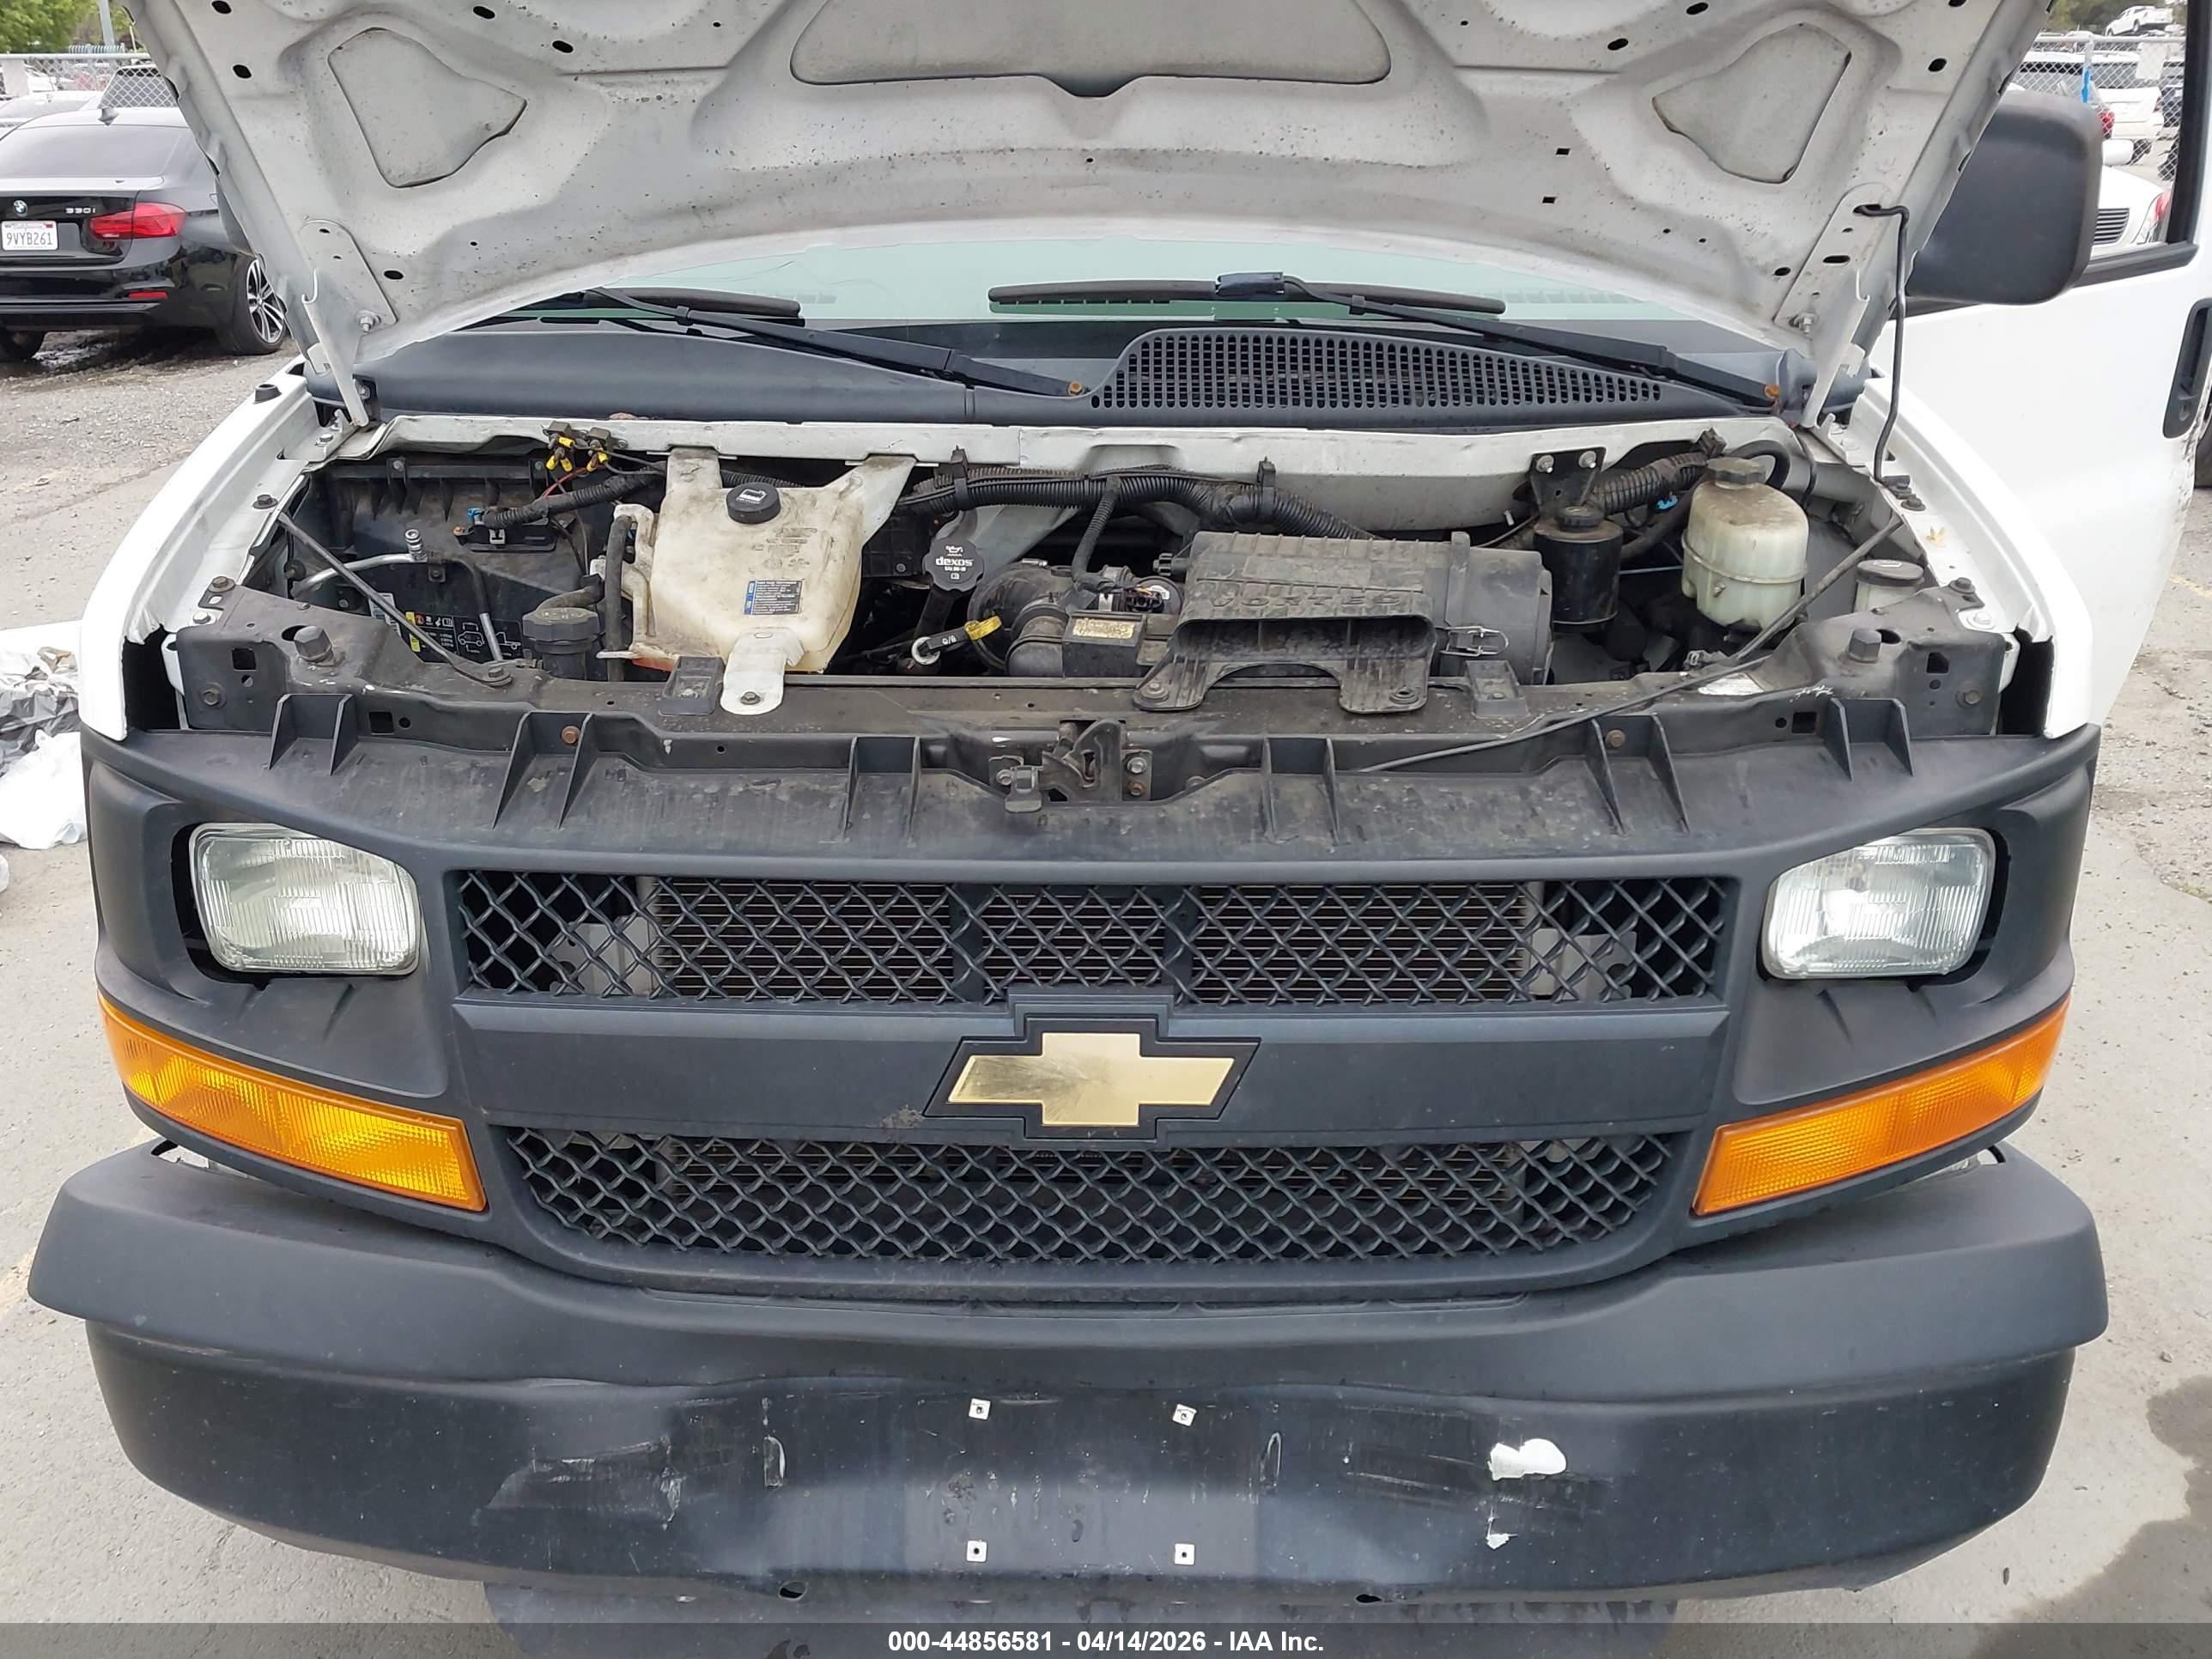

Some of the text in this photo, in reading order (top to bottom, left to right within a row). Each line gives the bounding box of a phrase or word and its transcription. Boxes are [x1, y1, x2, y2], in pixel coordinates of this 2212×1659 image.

[6, 232, 52, 246] 9VYB261
[935, 556, 974, 567] dexos
[1210, 594, 1401, 607] VORTEC
